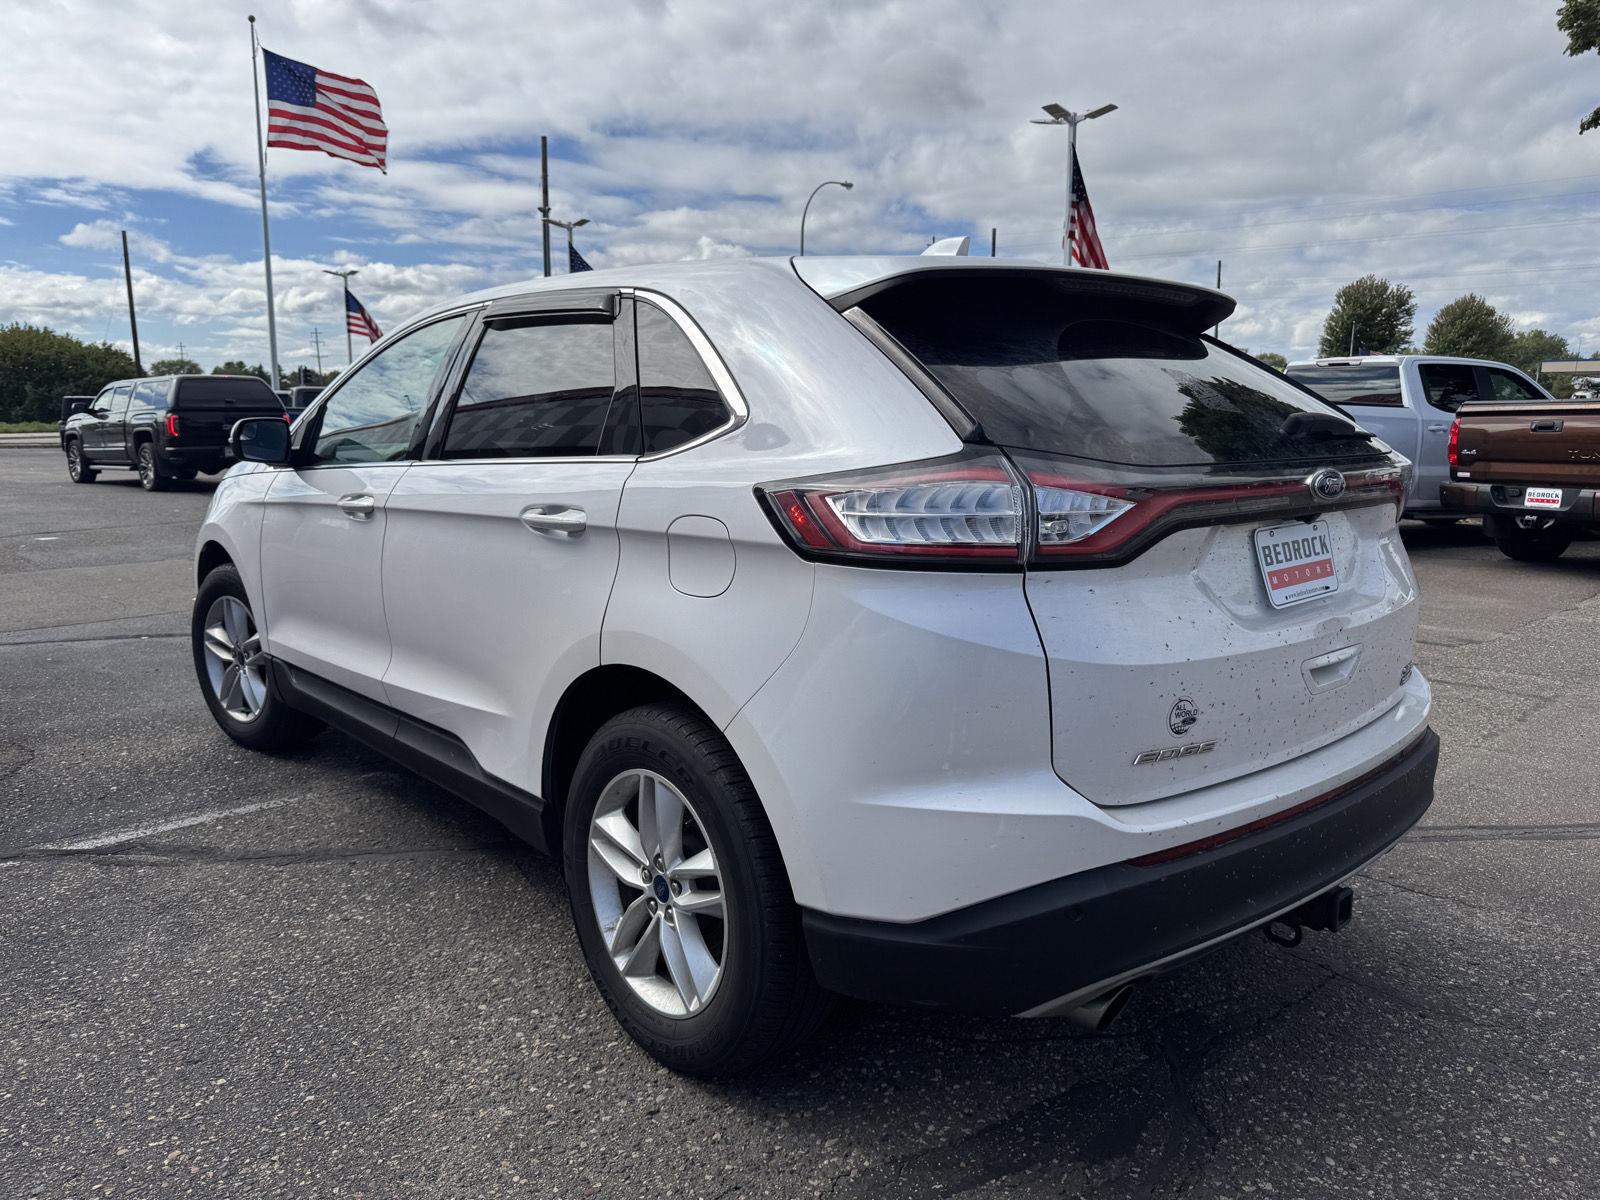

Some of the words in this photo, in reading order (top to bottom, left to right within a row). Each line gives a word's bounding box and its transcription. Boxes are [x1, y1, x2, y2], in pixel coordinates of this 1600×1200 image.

[1262, 535, 1329, 566] BEDROCK
[1271, 563, 1331, 584] MOTORS
[1175, 709, 1198, 718] WORLD
[1132, 740, 1217, 765] EDGE
